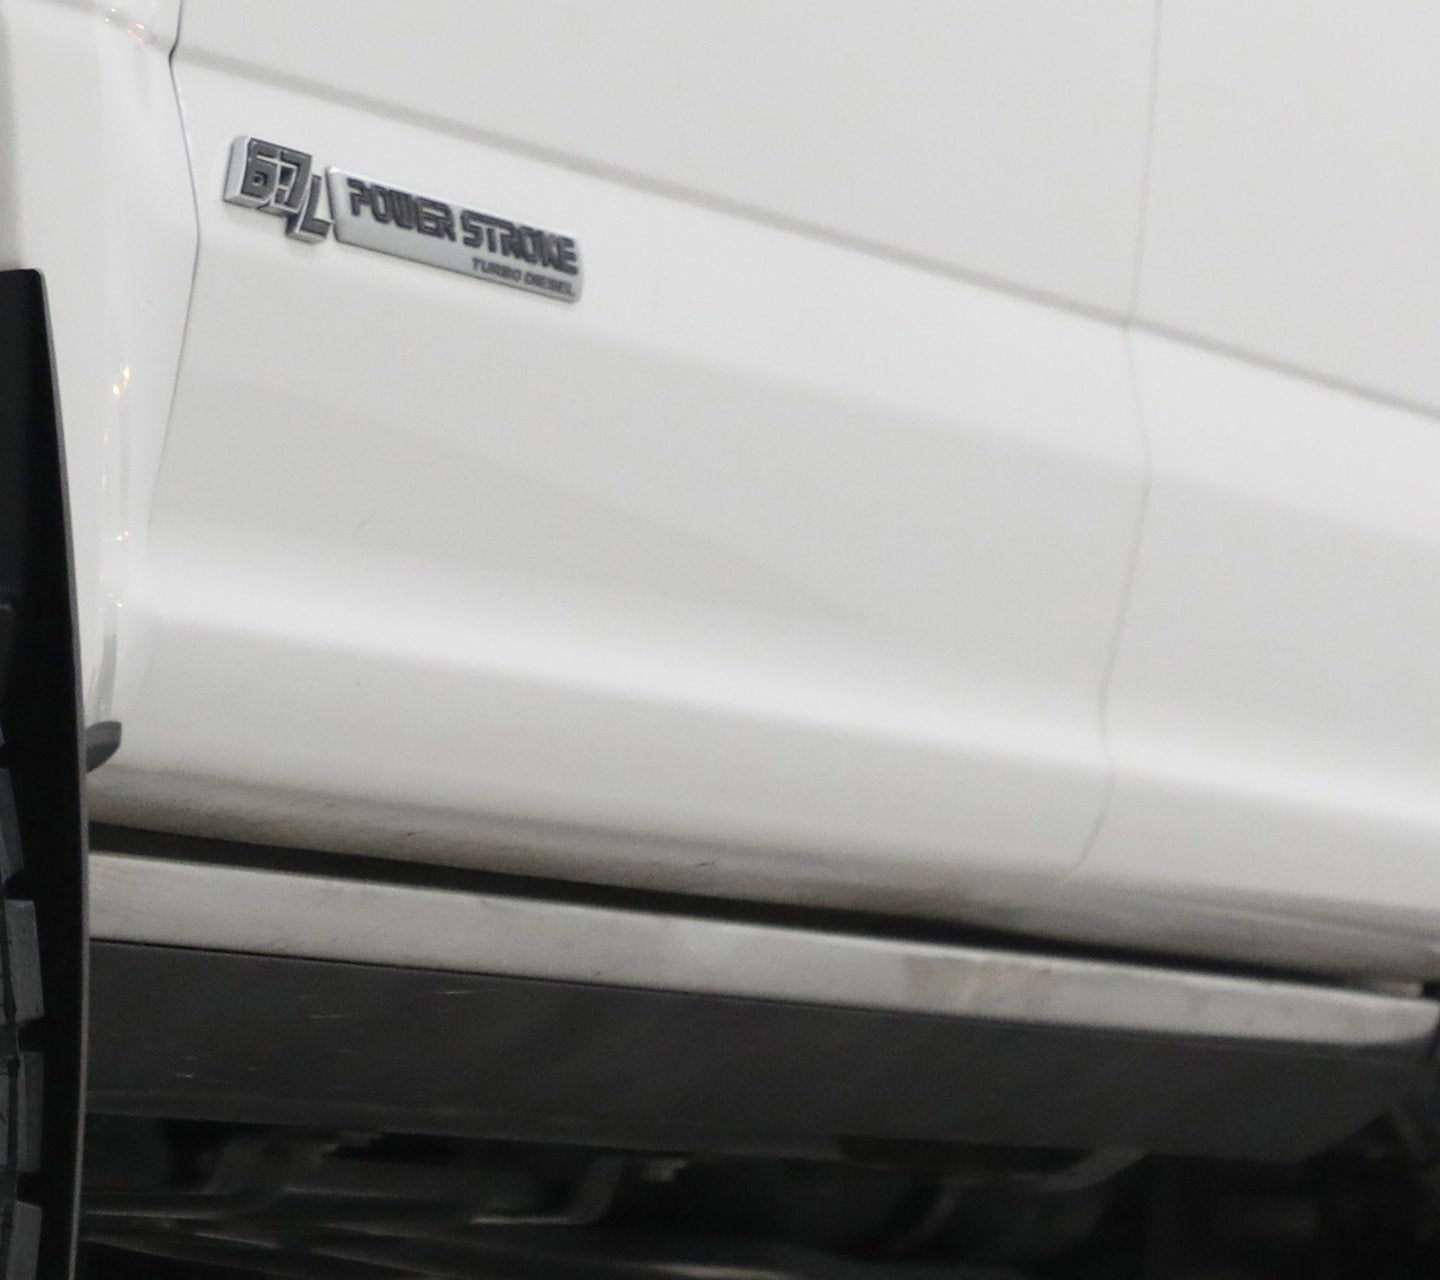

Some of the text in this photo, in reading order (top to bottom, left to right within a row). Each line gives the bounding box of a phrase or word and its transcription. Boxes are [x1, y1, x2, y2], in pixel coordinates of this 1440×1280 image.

[347, 177, 457, 242] POWER
[459, 209, 580, 276] STROKE
[472, 256, 522, 283] TURBO
